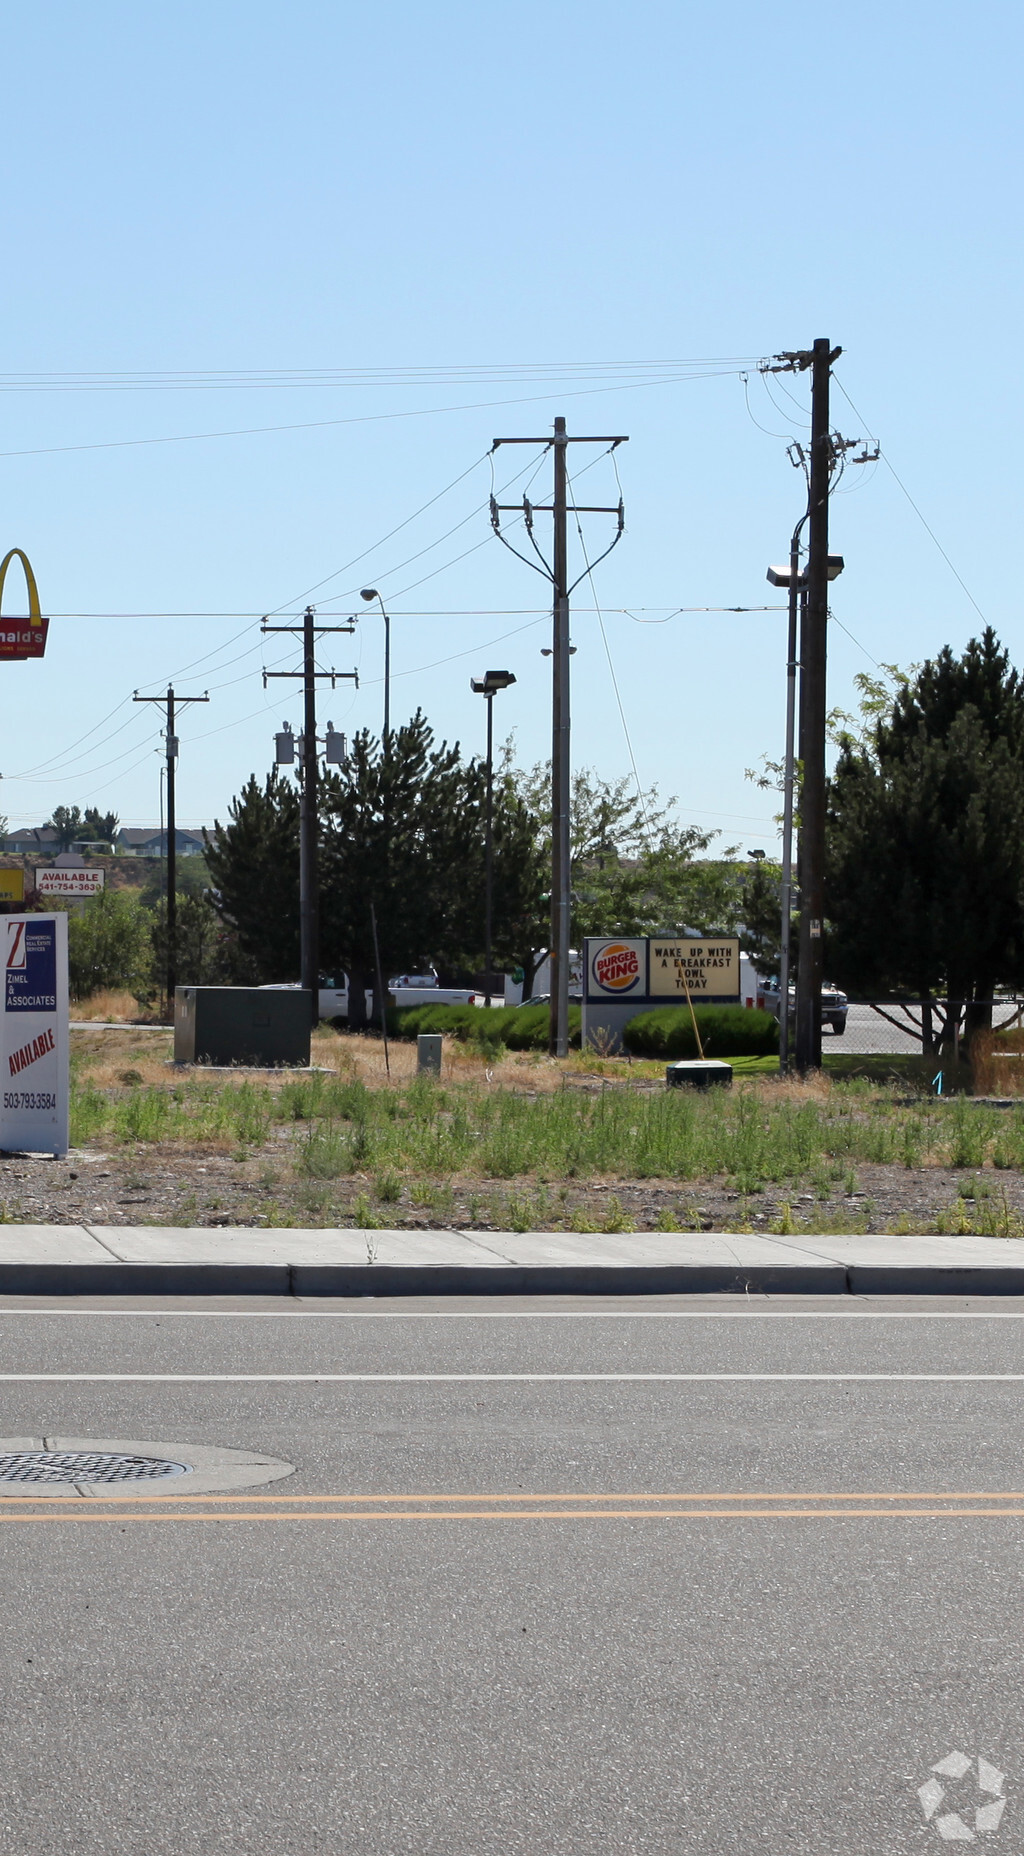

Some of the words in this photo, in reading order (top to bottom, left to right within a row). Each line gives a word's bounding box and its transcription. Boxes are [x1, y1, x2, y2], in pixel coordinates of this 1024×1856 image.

[42, 873, 99, 882] AVAILABLE
[655, 948, 682, 958] WAKE
[690, 948, 703, 958] UP
[709, 948, 732, 957] WITH
[597, 951, 637, 971] BURGER
[661, 958, 667, 968] A
[599, 960, 638, 984] KING
[7, 974, 28, 984] ZIMEL
[675, 979, 708, 989] TODAY
[8, 985, 15, 995] &
[7, 996, 56, 1006] ASSOCIATES
[8, 1028, 55, 1077] AVAILABLE
[3, 1092, 56, 1109] 503-793-3584
